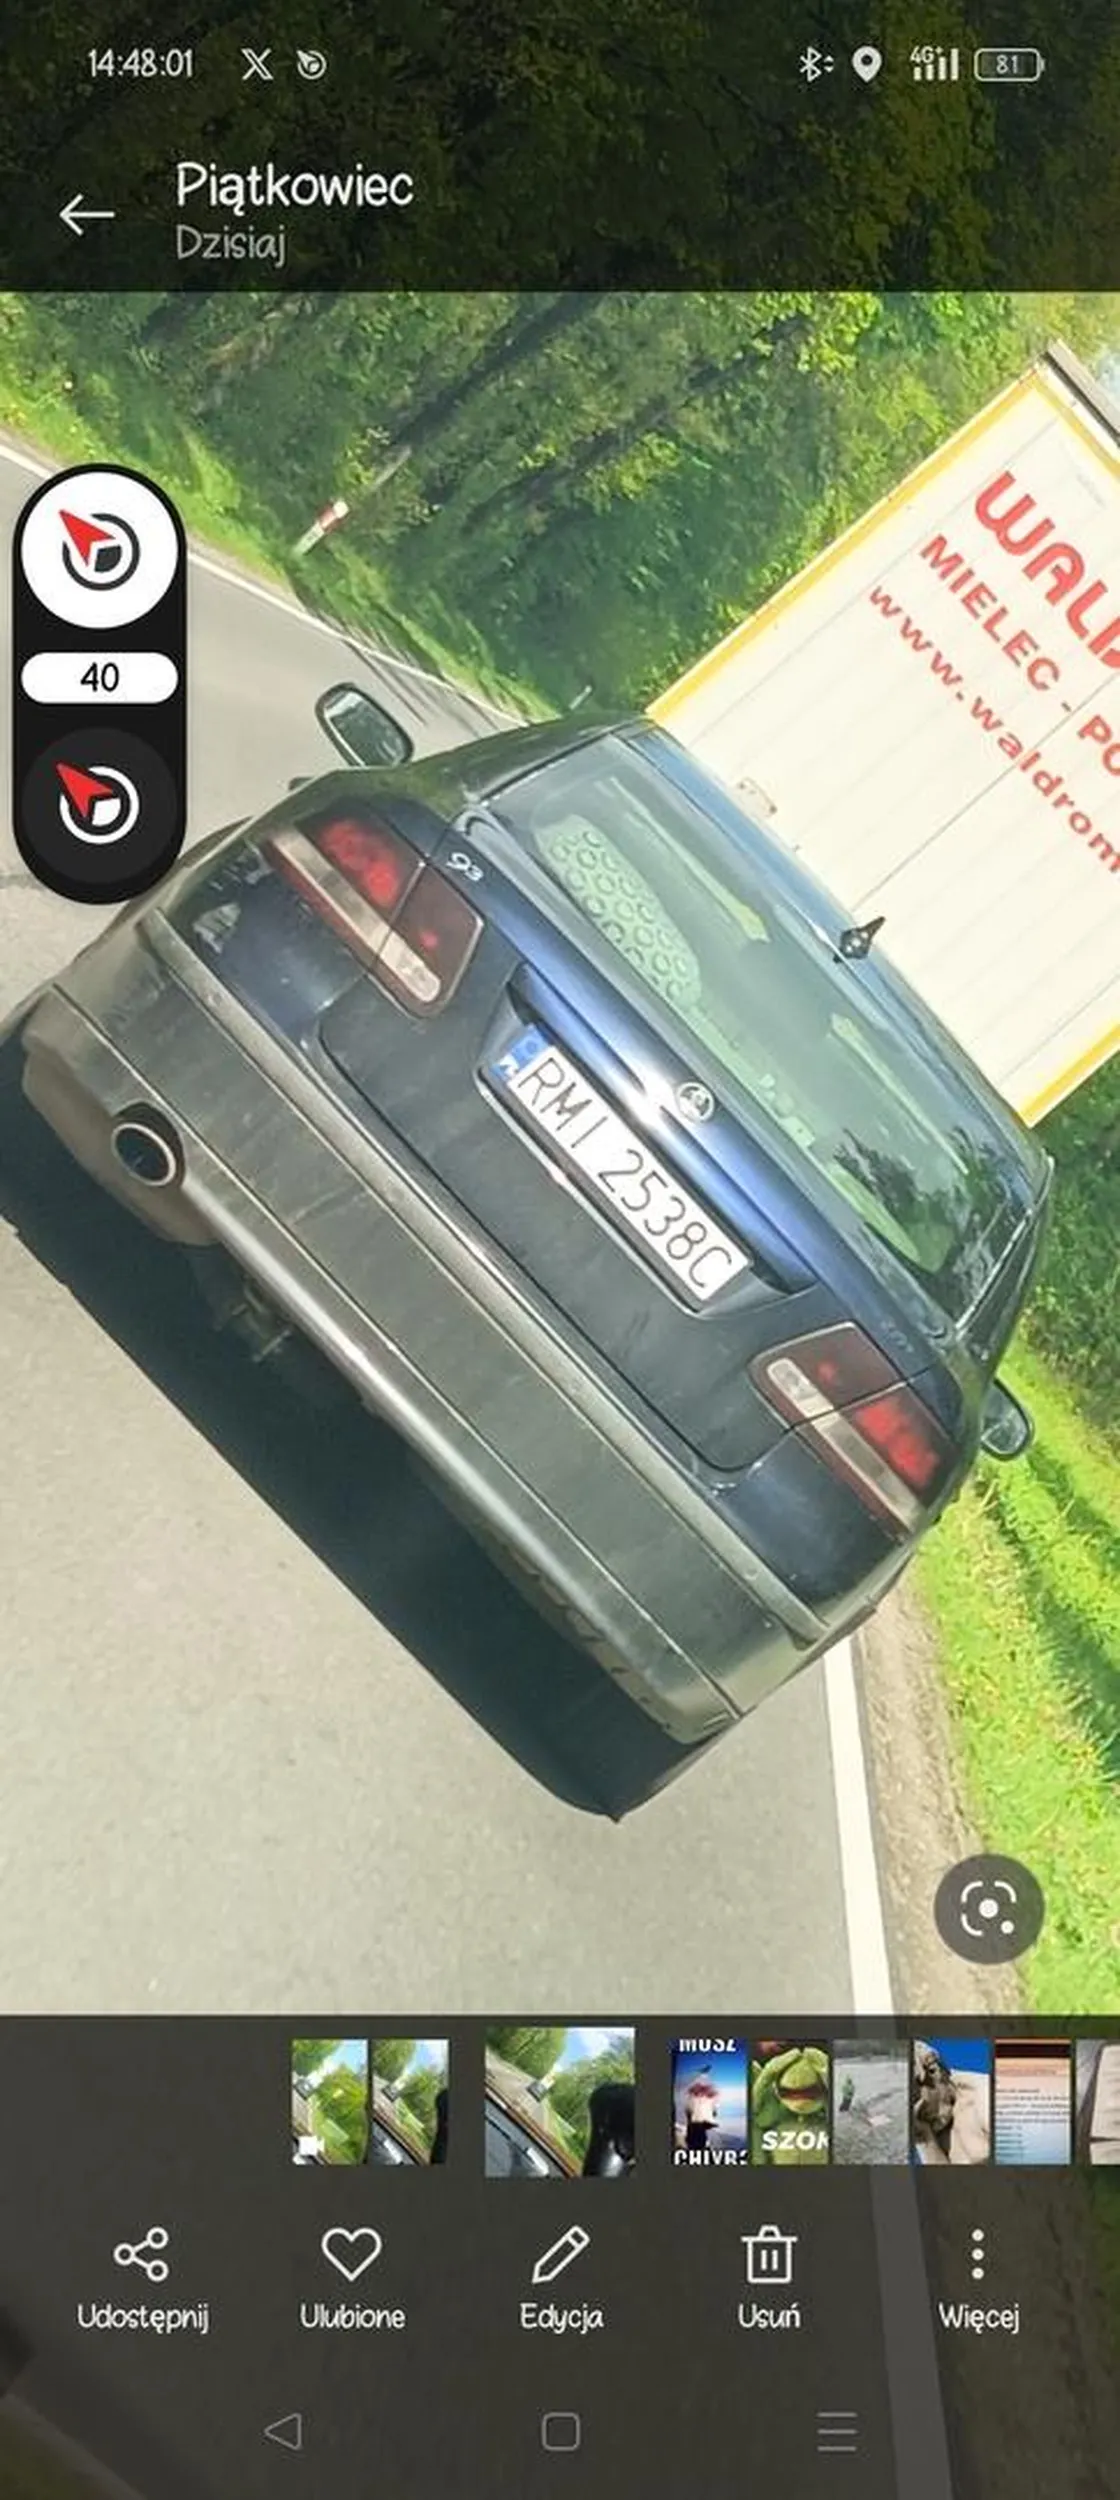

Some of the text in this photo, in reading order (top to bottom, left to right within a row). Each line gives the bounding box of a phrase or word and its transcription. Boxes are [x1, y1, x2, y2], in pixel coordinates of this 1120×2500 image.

[868, 585, 1120, 873] www.waldrom
[920, 534, 1060, 691] MIELEC
[517, 1056, 733, 1289] RMI 2538C
